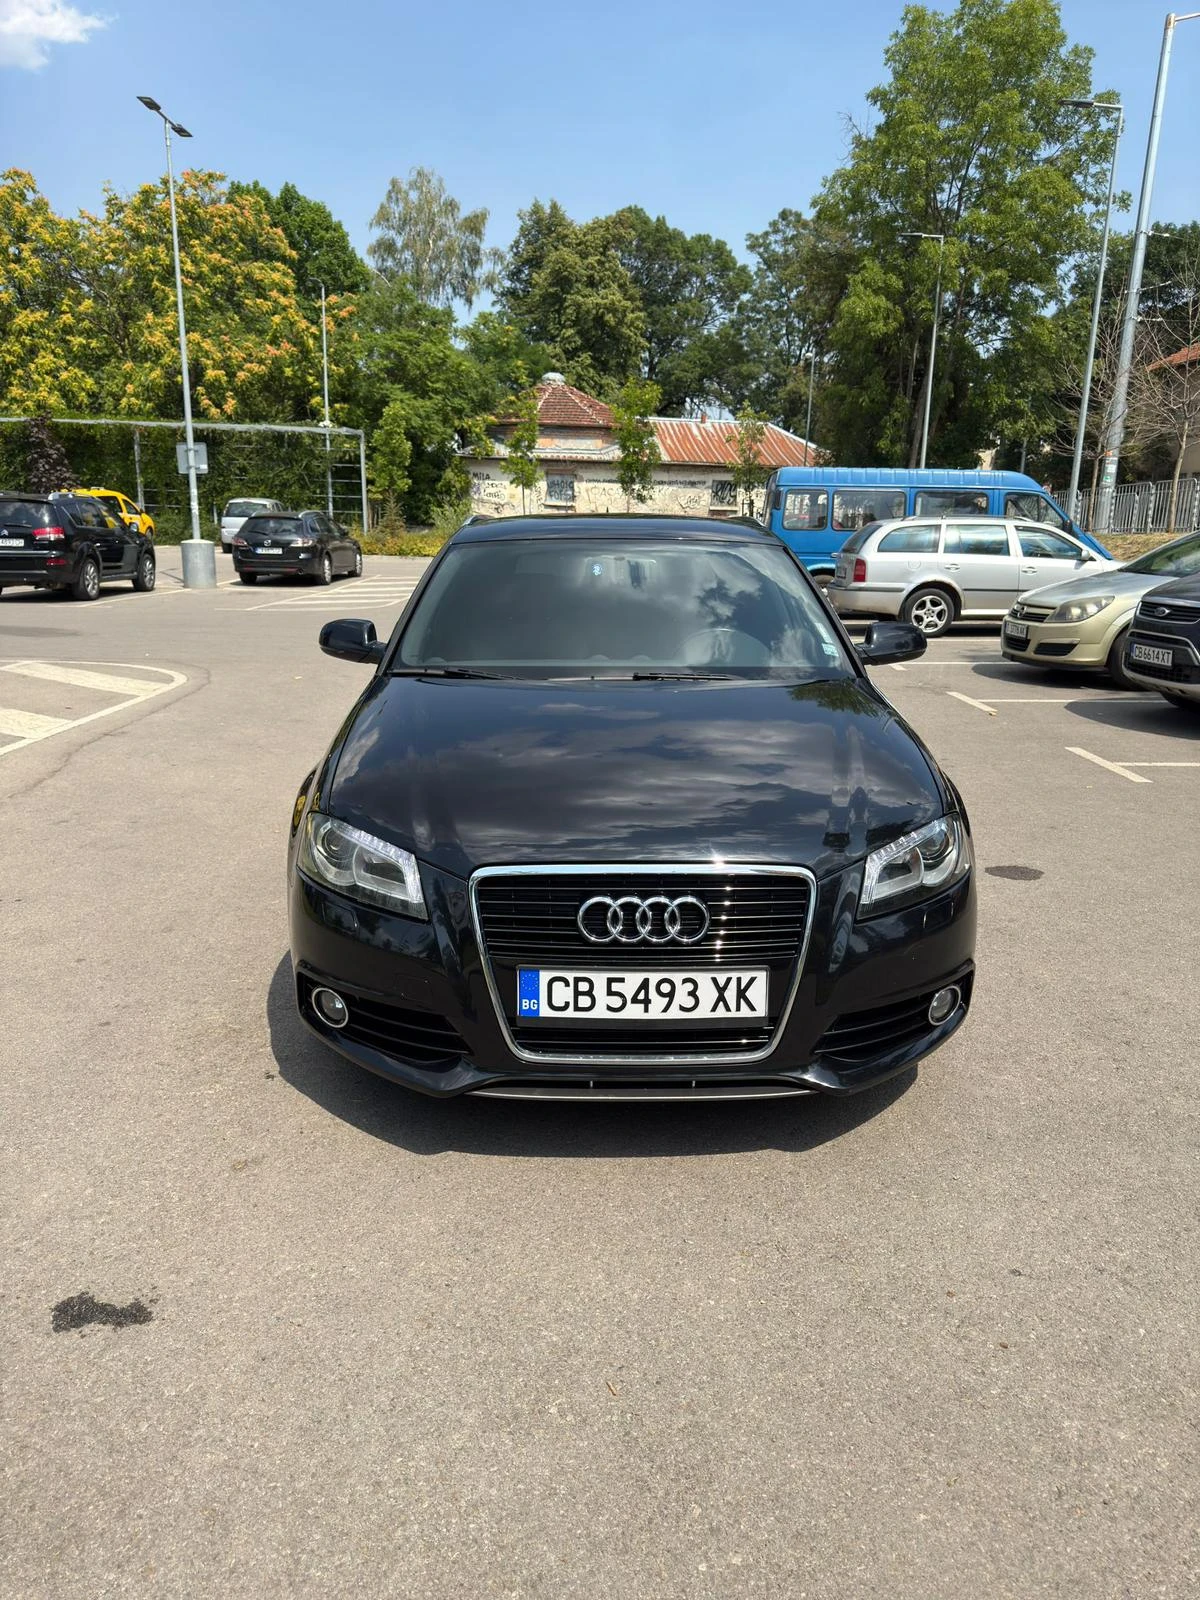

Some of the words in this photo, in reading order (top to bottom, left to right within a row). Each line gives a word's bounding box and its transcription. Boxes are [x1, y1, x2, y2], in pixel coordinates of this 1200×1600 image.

[521, 999, 538, 1011] BG
[546, 975, 597, 1013] CB
[605, 976, 700, 1014] 5493
[709, 976, 758, 1013] XK
